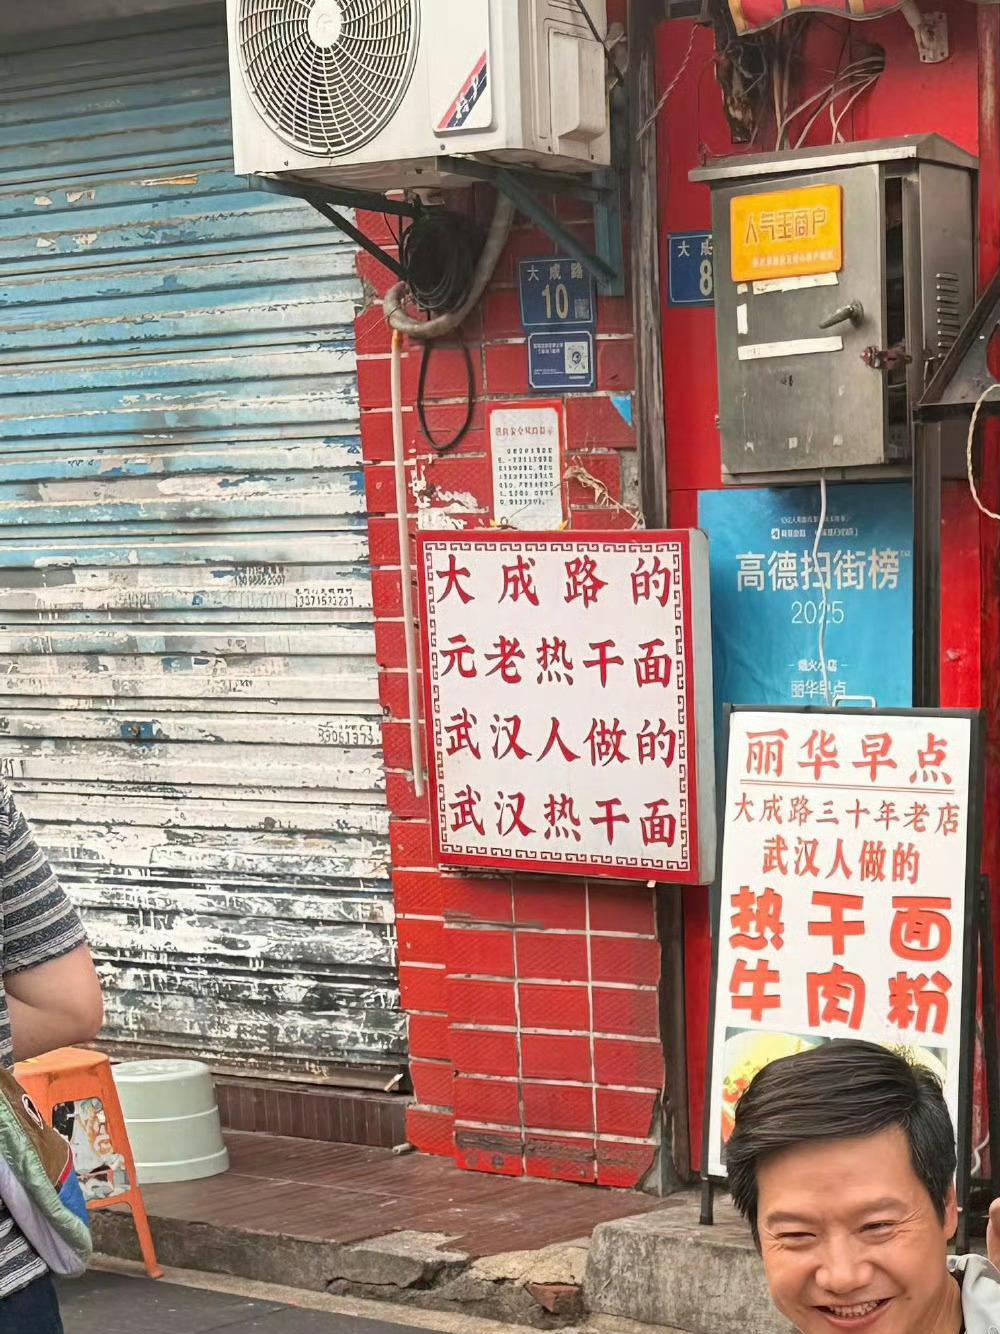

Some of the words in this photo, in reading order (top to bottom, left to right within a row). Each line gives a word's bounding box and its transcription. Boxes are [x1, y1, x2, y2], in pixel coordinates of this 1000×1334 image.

[526, 262, 584, 282] 大成路
[541, 283, 569, 319] 10
[436, 554, 672, 609] 大成路的
[735, 548, 900, 592] 高德扫街榜
[791, 600, 845, 624] 2025
[439, 633, 673, 689] 元老热干面
[444, 707, 677, 769] 武汉人做的
[745, 728, 952, 785] 丽华早点
[448, 784, 678, 848] 武汉热干面
[732, 791, 961, 836] 大成路三十年老店
[761, 834, 921, 885] 武汉人做的
[728, 885, 952, 962] 热干面
[728, 958, 953, 1035] 牛肉粉
